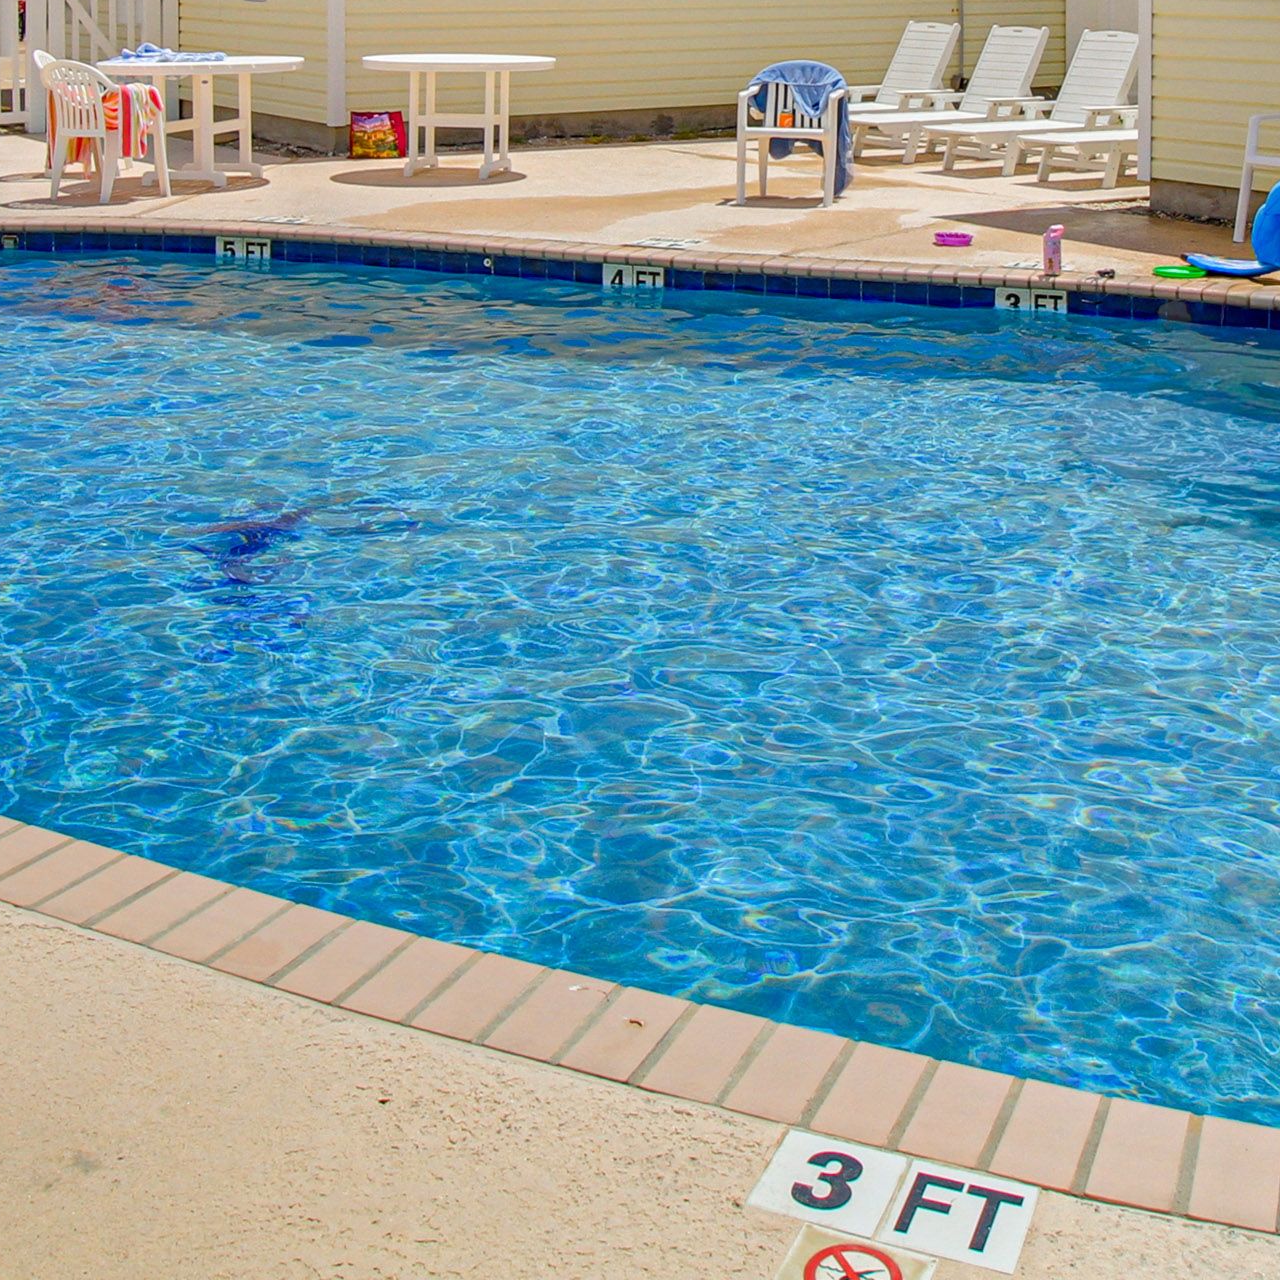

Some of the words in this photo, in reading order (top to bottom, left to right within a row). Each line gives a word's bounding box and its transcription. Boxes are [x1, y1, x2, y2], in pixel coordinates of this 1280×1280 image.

[223, 241, 236, 259] 5
[246, 242, 268, 259] FT
[610, 269, 623, 286] 4
[636, 271, 660, 287] FT
[1005, 293, 1021, 309] 3
[1034, 294, 1063, 312] FT
[790, 1151, 864, 1210] 3
[893, 1171, 1025, 1253] FT
